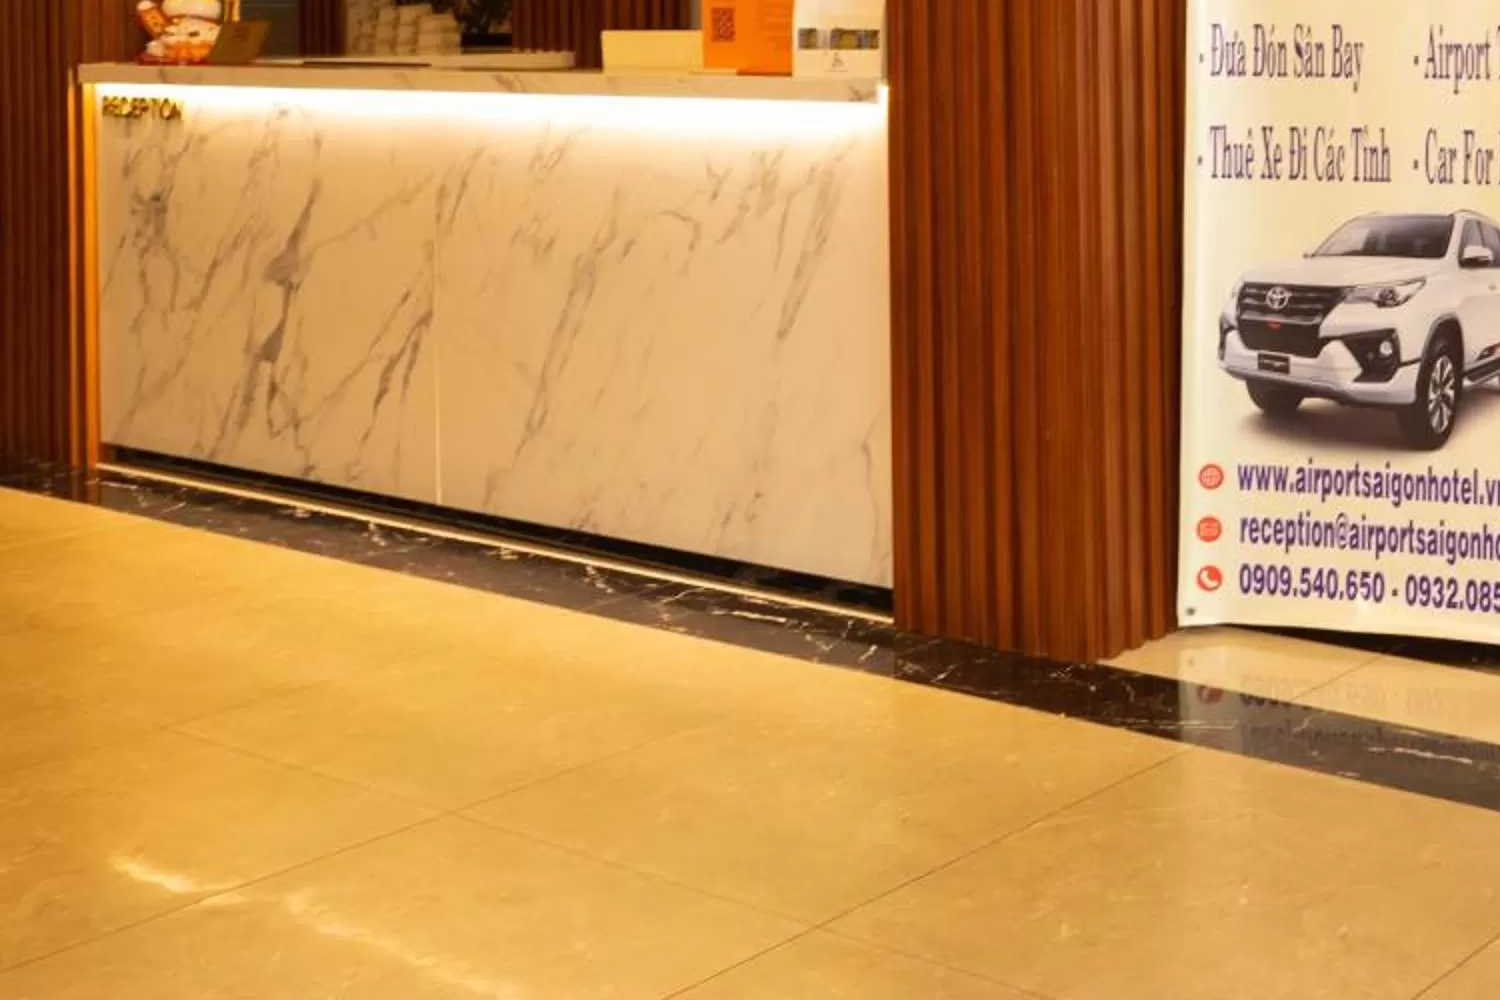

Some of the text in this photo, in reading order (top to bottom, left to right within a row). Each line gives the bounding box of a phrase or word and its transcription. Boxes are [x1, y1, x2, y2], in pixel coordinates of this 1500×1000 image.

[1252, 23, 1288, 78] Đón
[1293, 23, 1326, 78] Sân
[1331, 24, 1364, 93] Bay
[1424, 23, 1491, 95] Airport
[1209, 124, 1255, 180] Thuê
[1260, 125, 1282, 180] Xe
[1288, 126, 1308, 181] Đi
[1313, 126, 1345, 182] Các
[1424, 127, 1457, 185] Car
[1463, 129, 1494, 186] For
[1239, 563, 1385, 603] 0909.540.650
